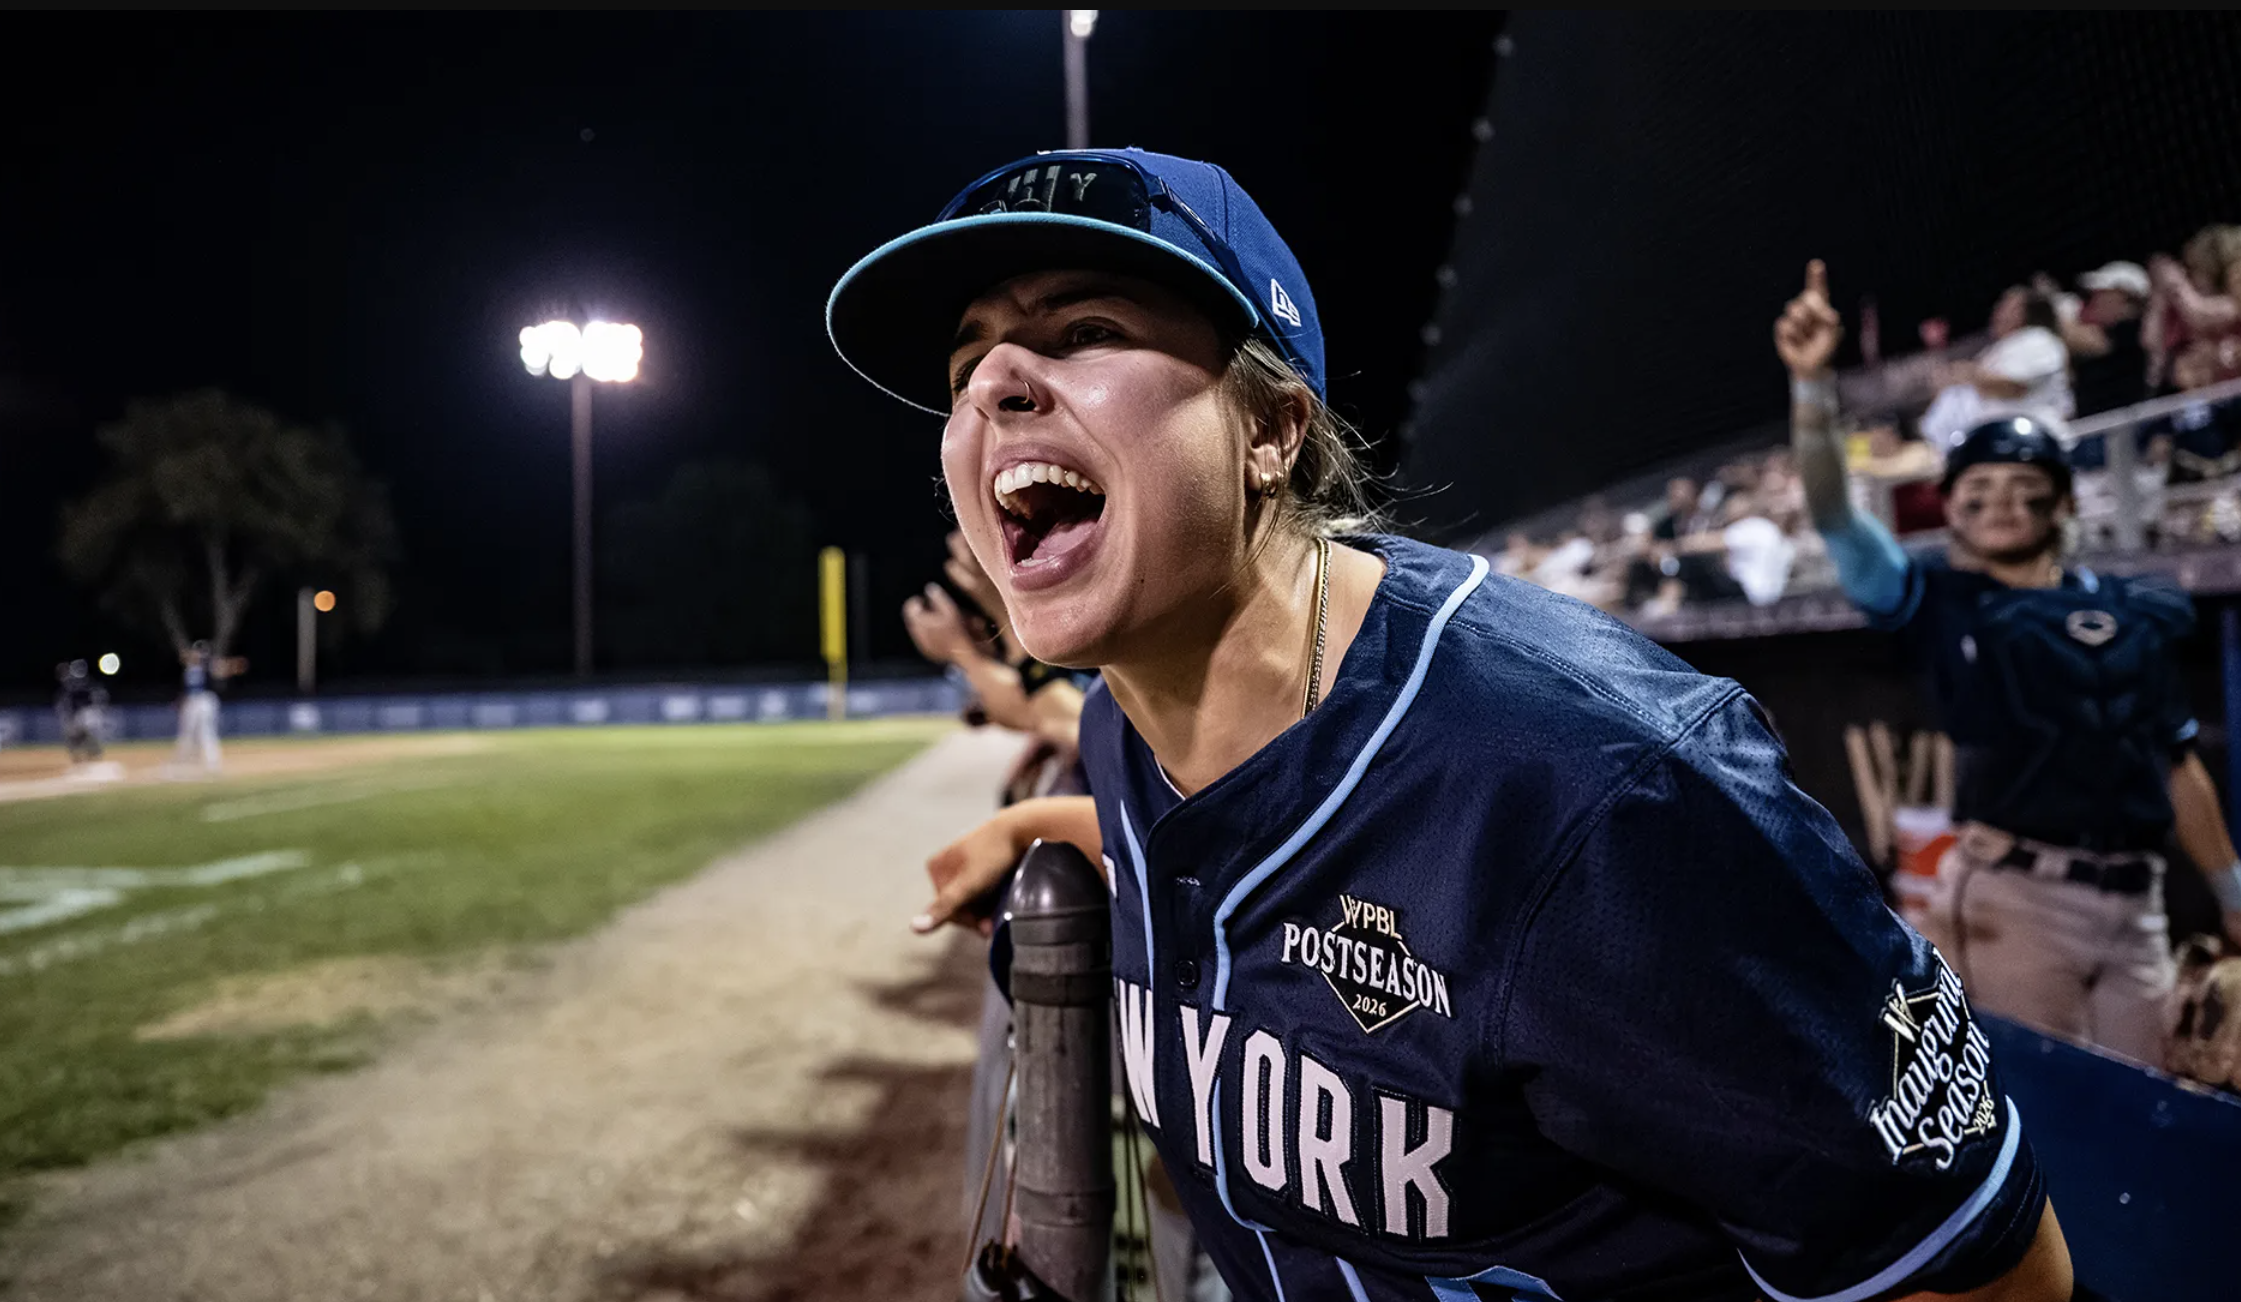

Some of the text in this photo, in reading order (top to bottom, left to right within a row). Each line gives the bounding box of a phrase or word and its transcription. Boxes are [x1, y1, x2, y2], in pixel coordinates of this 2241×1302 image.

[1339, 895, 1402, 940] WPBL
[1281, 922, 1451, 1018] POSTSEASON
[1352, 994, 1387, 1017] 2026
[1179, 1005, 1454, 1239] YORK
[1918, 1021, 1991, 1169] Season
